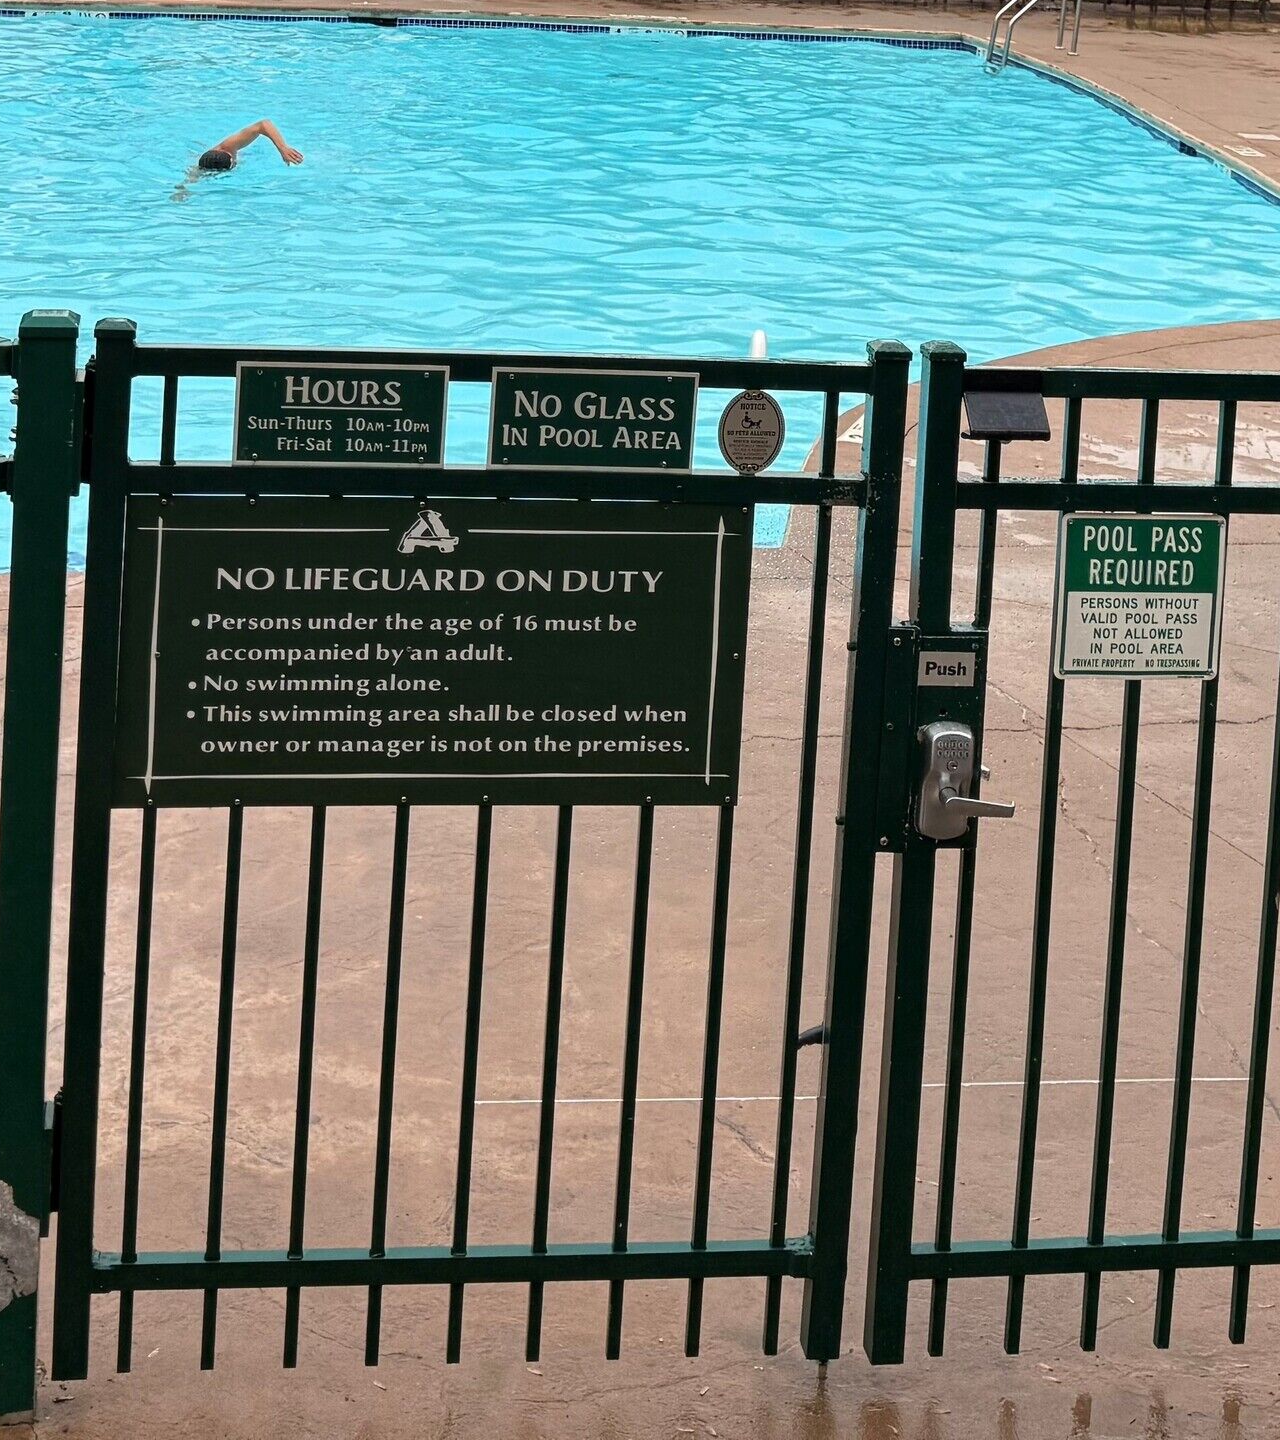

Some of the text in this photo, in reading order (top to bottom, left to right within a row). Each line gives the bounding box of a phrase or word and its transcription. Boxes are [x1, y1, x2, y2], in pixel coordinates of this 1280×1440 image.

[281, 375, 403, 406] HOURS
[513, 390, 676, 422] NO GLASS
[740, 403, 767, 411] NOTICE
[247, 415, 430, 433] Sun-Thurs 10AM-10PM
[277, 437, 428, 453] Fri-Sat 10AM-11PM
[502, 424, 683, 450] IN POOL AREA
[1083, 525, 1203, 554] POOL PASS
[216, 567, 664, 594] NO LIFEGUARD ON DUTY
[1089, 558, 1194, 588] REQUIRED
[1080, 597, 1199, 610] PERSONS WITHOUT
[207, 612, 637, 636] Persons under the age of 16 must be
[1081, 612, 1198, 625] VALID POOL PASS
[1093, 627, 1183, 640] NOT ALLOWED
[205, 642, 513, 666] accompanied by an adult.
[1090, 642, 1184, 655] IN POOL AREA
[925, 661, 967, 677] Push
[1072, 659, 1200, 668] PRIVATE PROPERTY NO TRESPASSING
[203, 674, 450, 697] No swimming alone.
[202, 704, 687, 727] This swimming area shall be closed when
[200, 734, 690, 758] owner or manager is not on the premises.
